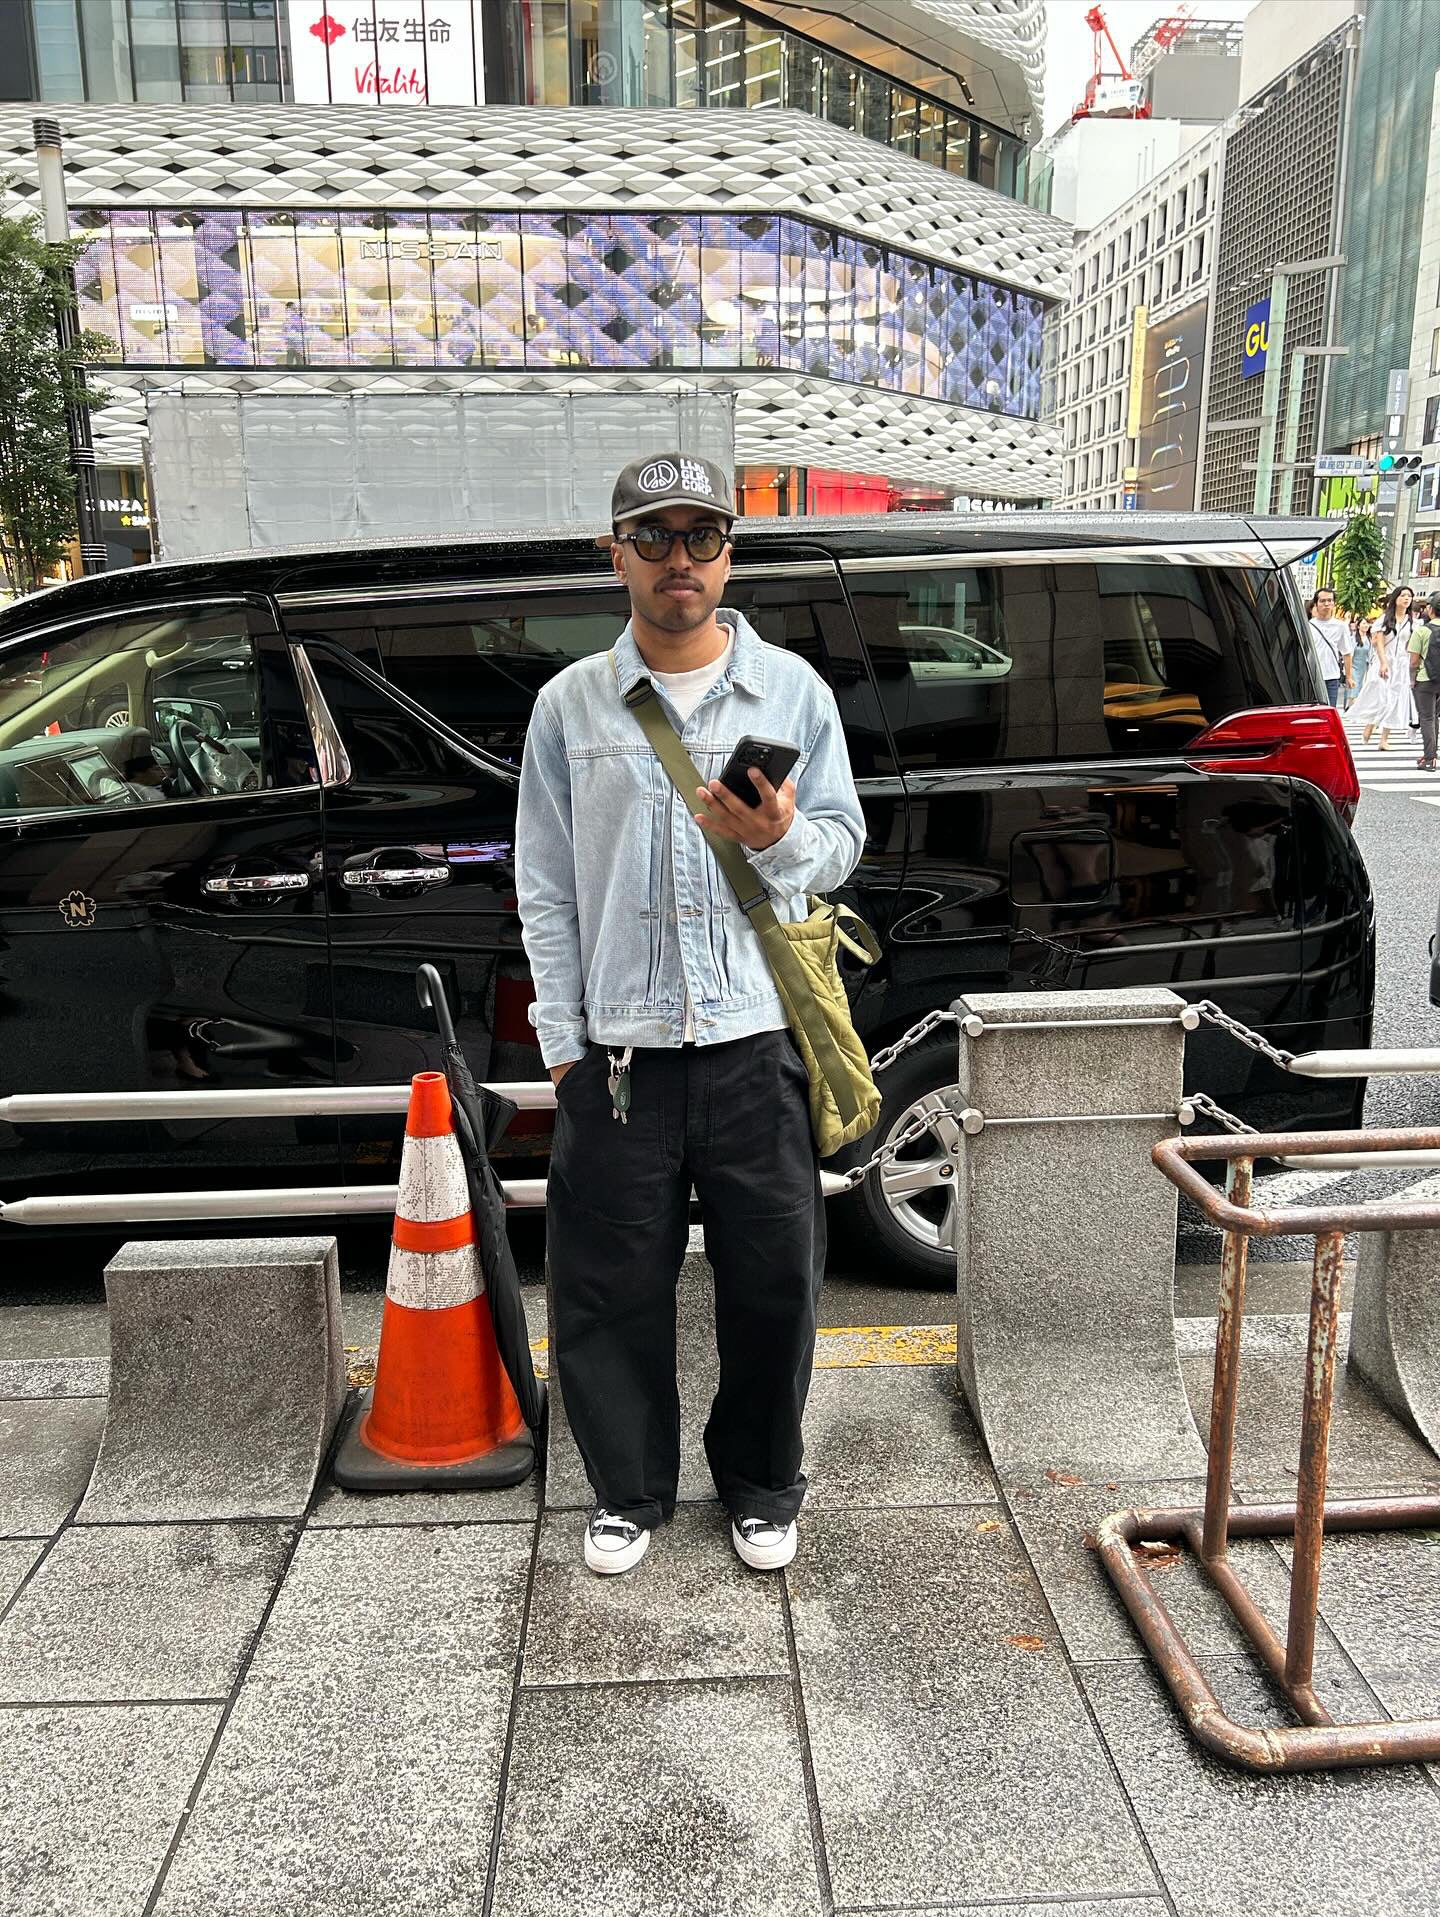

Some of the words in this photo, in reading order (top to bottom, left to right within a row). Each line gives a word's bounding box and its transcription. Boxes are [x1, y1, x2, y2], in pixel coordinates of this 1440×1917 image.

[352, 17, 452, 43] 住友生命
[355, 60, 429, 105] Vitality
[360, 240, 502, 260] NISSAN
[1246, 321, 1270, 357] GU
[682, 479, 715, 498] CORP.
[70, 902, 87, 917] N
